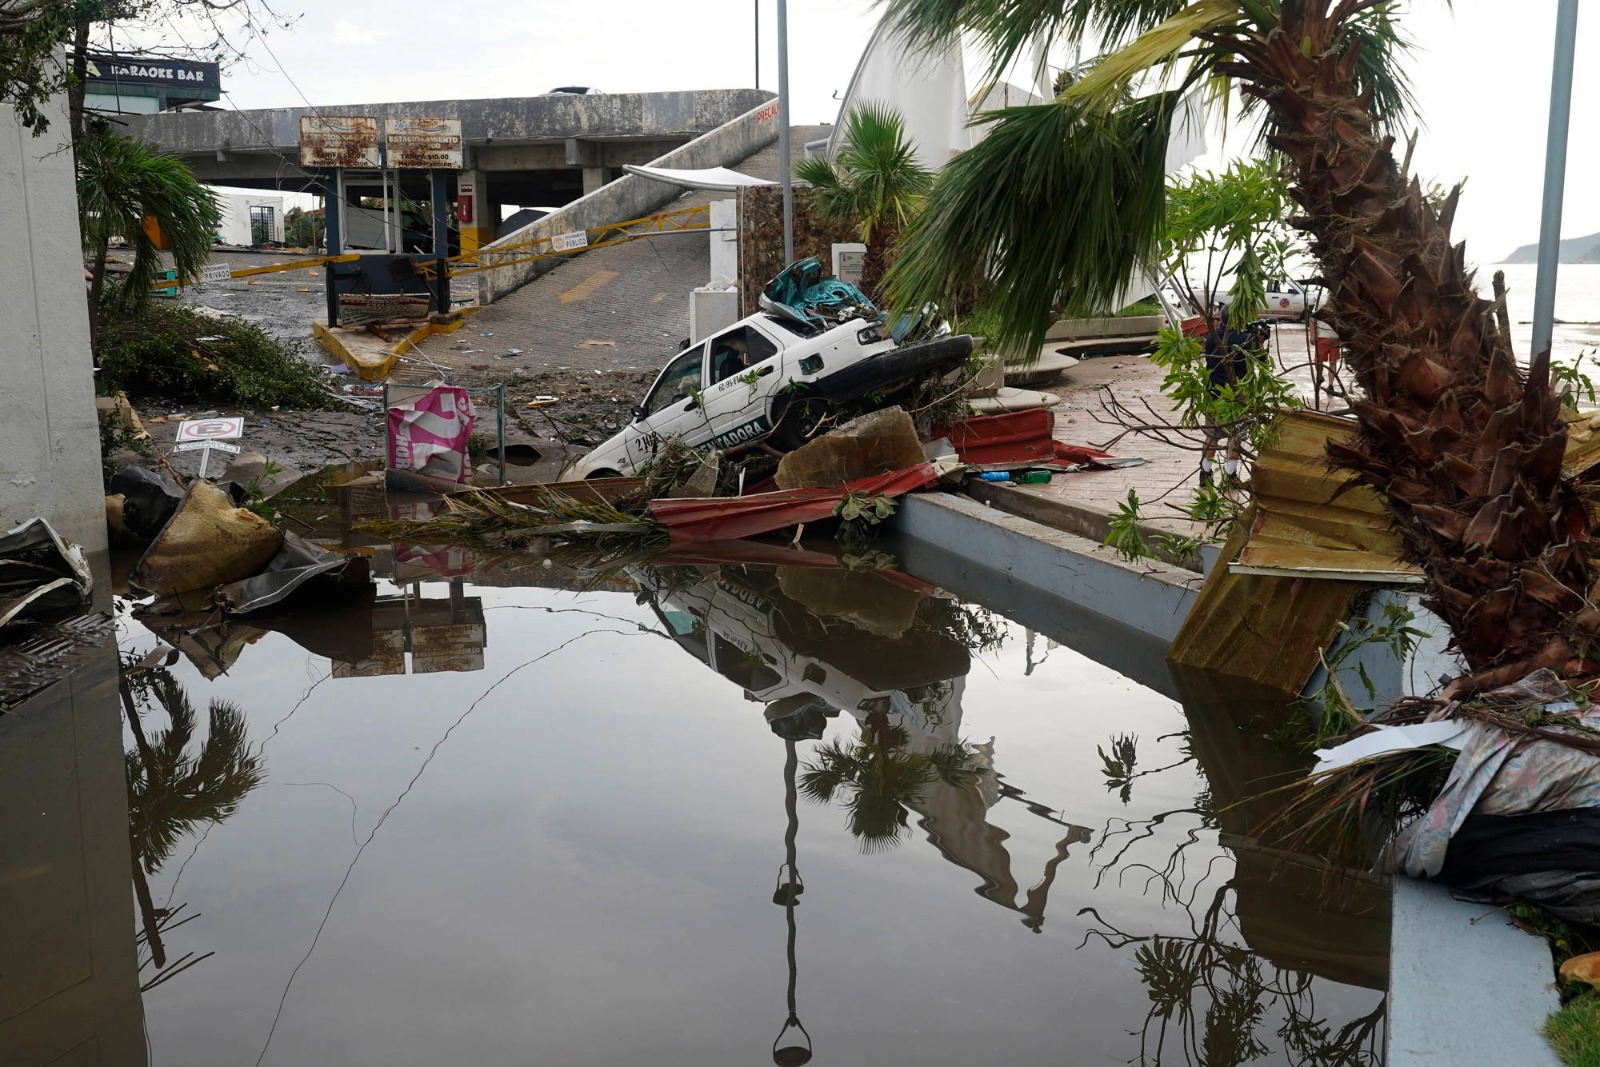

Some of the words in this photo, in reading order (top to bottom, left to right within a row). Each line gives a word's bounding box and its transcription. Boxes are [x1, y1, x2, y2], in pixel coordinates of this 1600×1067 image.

[111, 65, 173, 79] KARAOKE
[177, 69, 204, 82] BAR
[205, 270, 230, 279] PRIVADO
[693, 421, 766, 455] ENTADORA
